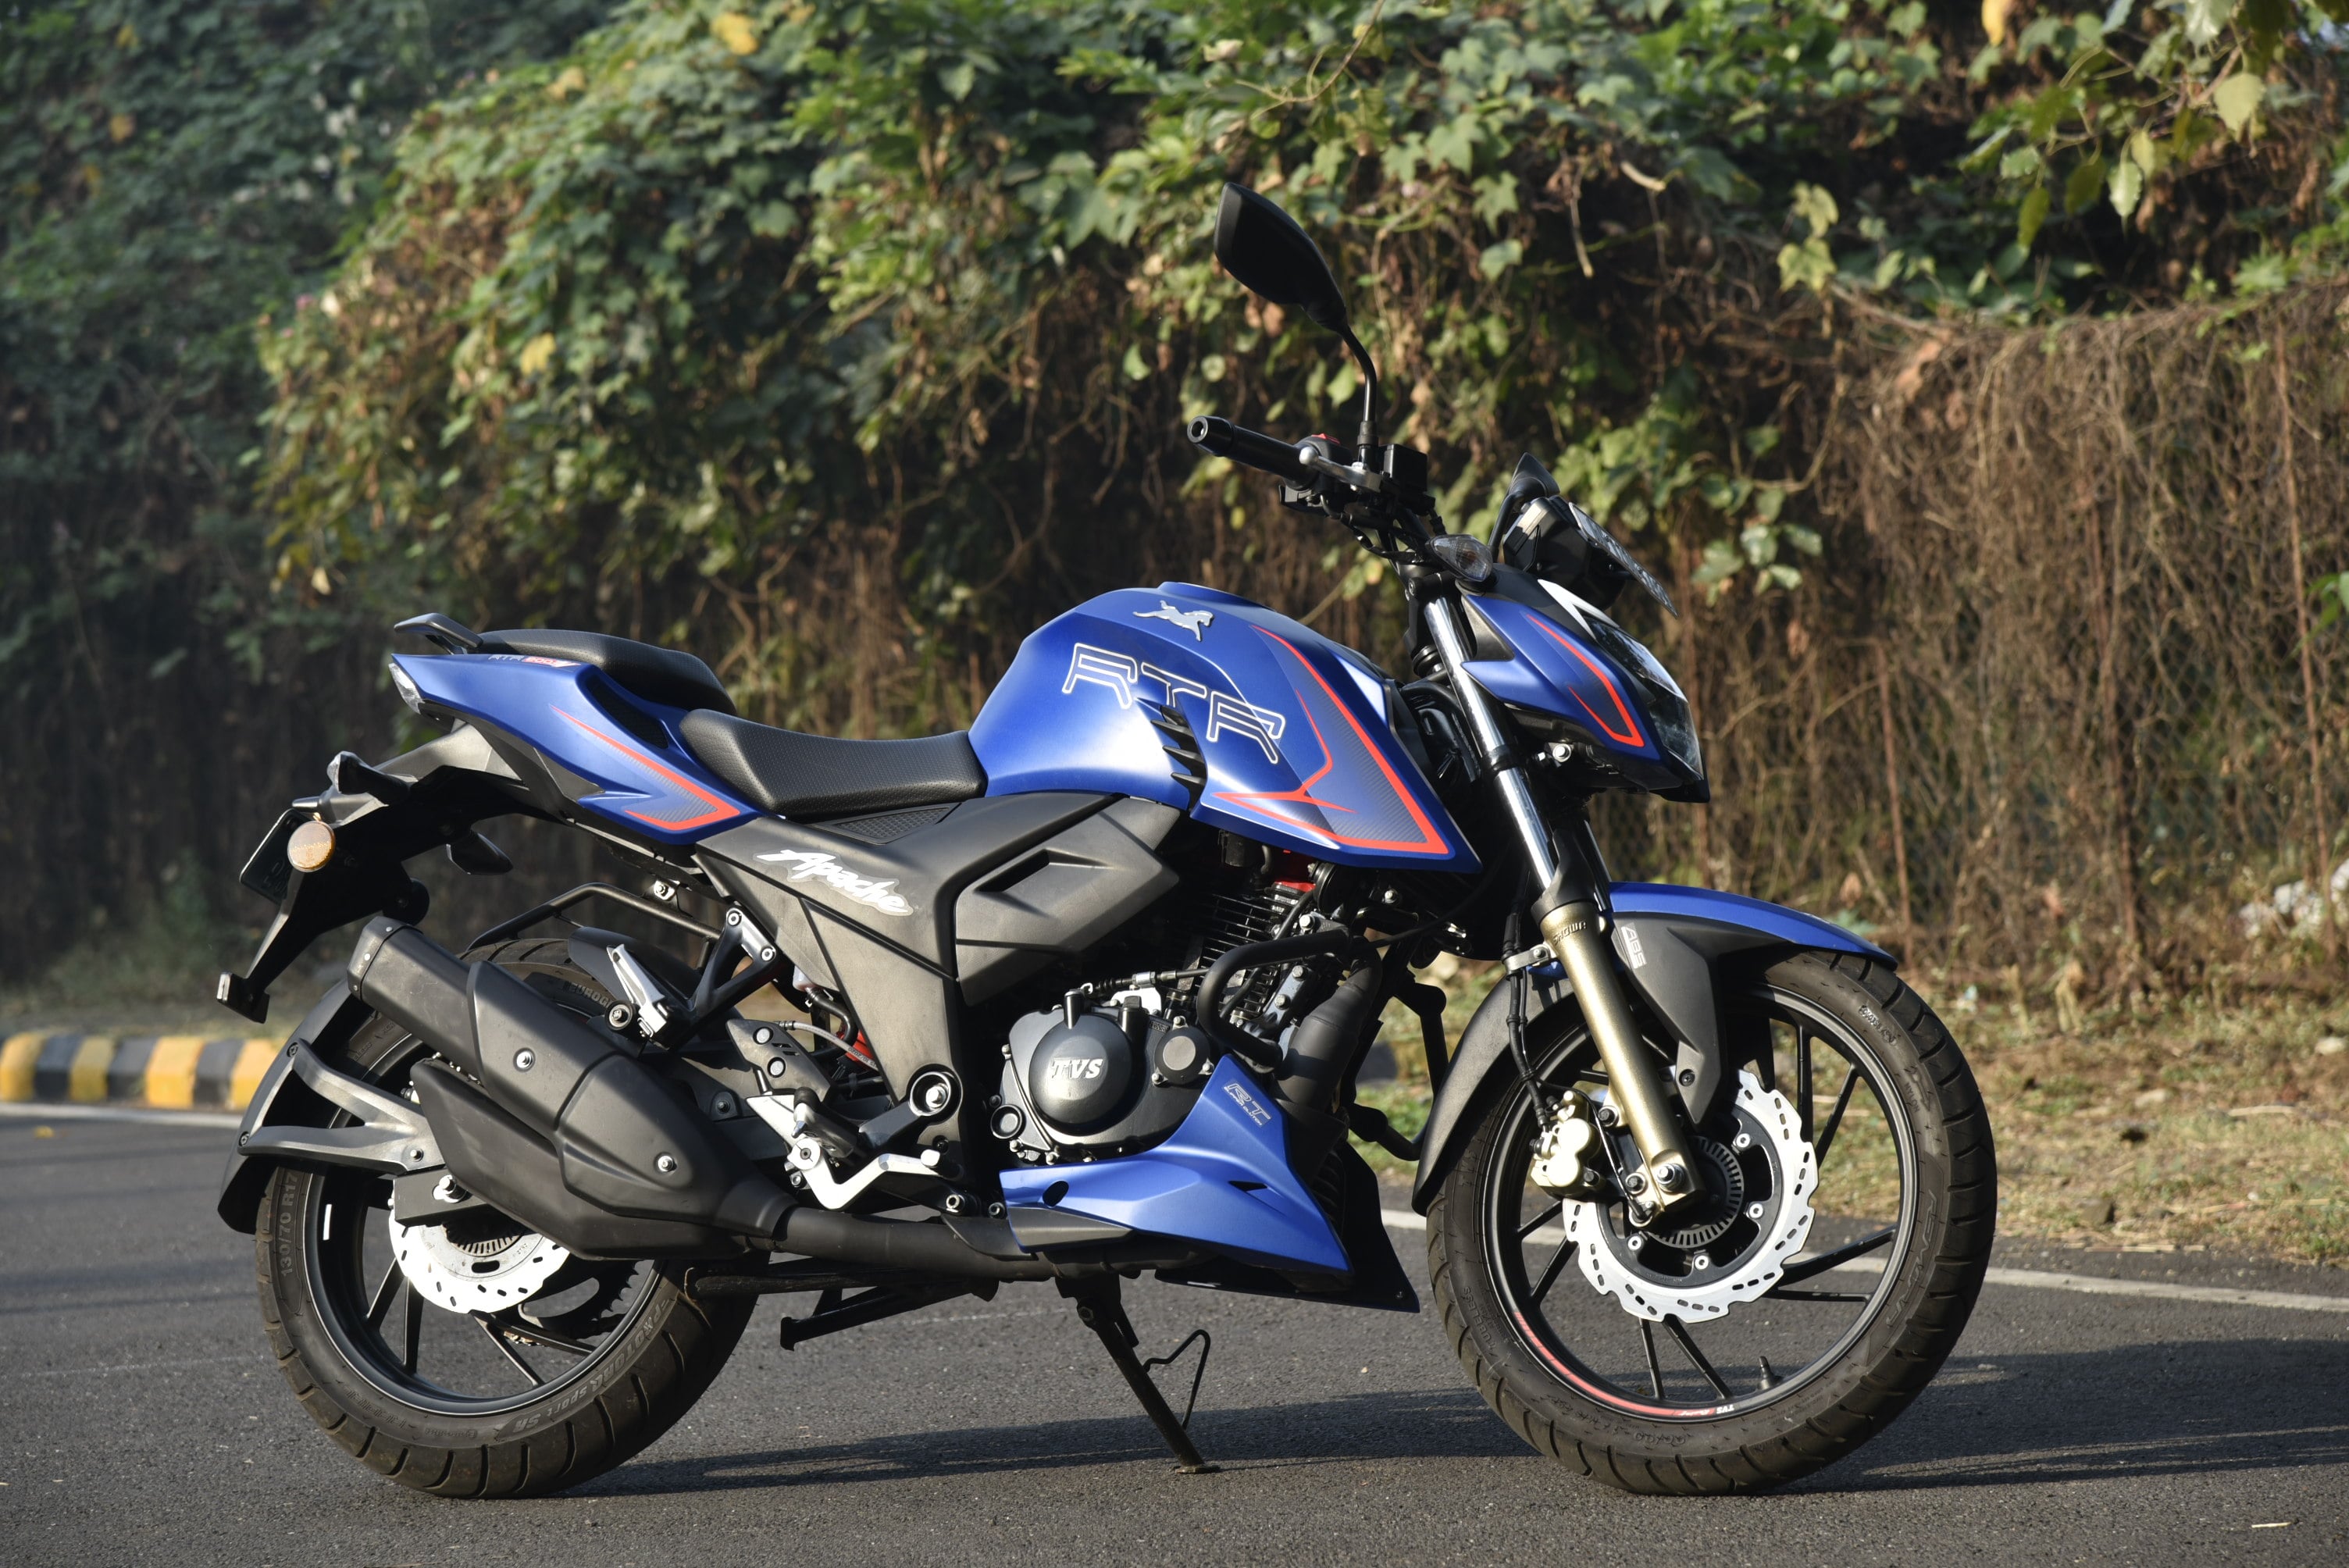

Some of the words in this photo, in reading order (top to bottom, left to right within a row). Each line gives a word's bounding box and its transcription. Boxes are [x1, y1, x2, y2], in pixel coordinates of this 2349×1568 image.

[1062, 642, 1286, 764] RTR
[755, 849, 908, 913] Apache
[1552, 921, 1587, 946] SHOWA
[1624, 925, 1647, 967] ABS
[1051, 1057, 1103, 1080] TVS
[1226, 1083, 1271, 1120] RT
[280, 1172, 298, 1207] R17
[278, 1212, 294, 1278] 130/70
[1462, 1285, 1497, 1355] TUBELESS
[1716, 1404, 1735, 1415] TVS
